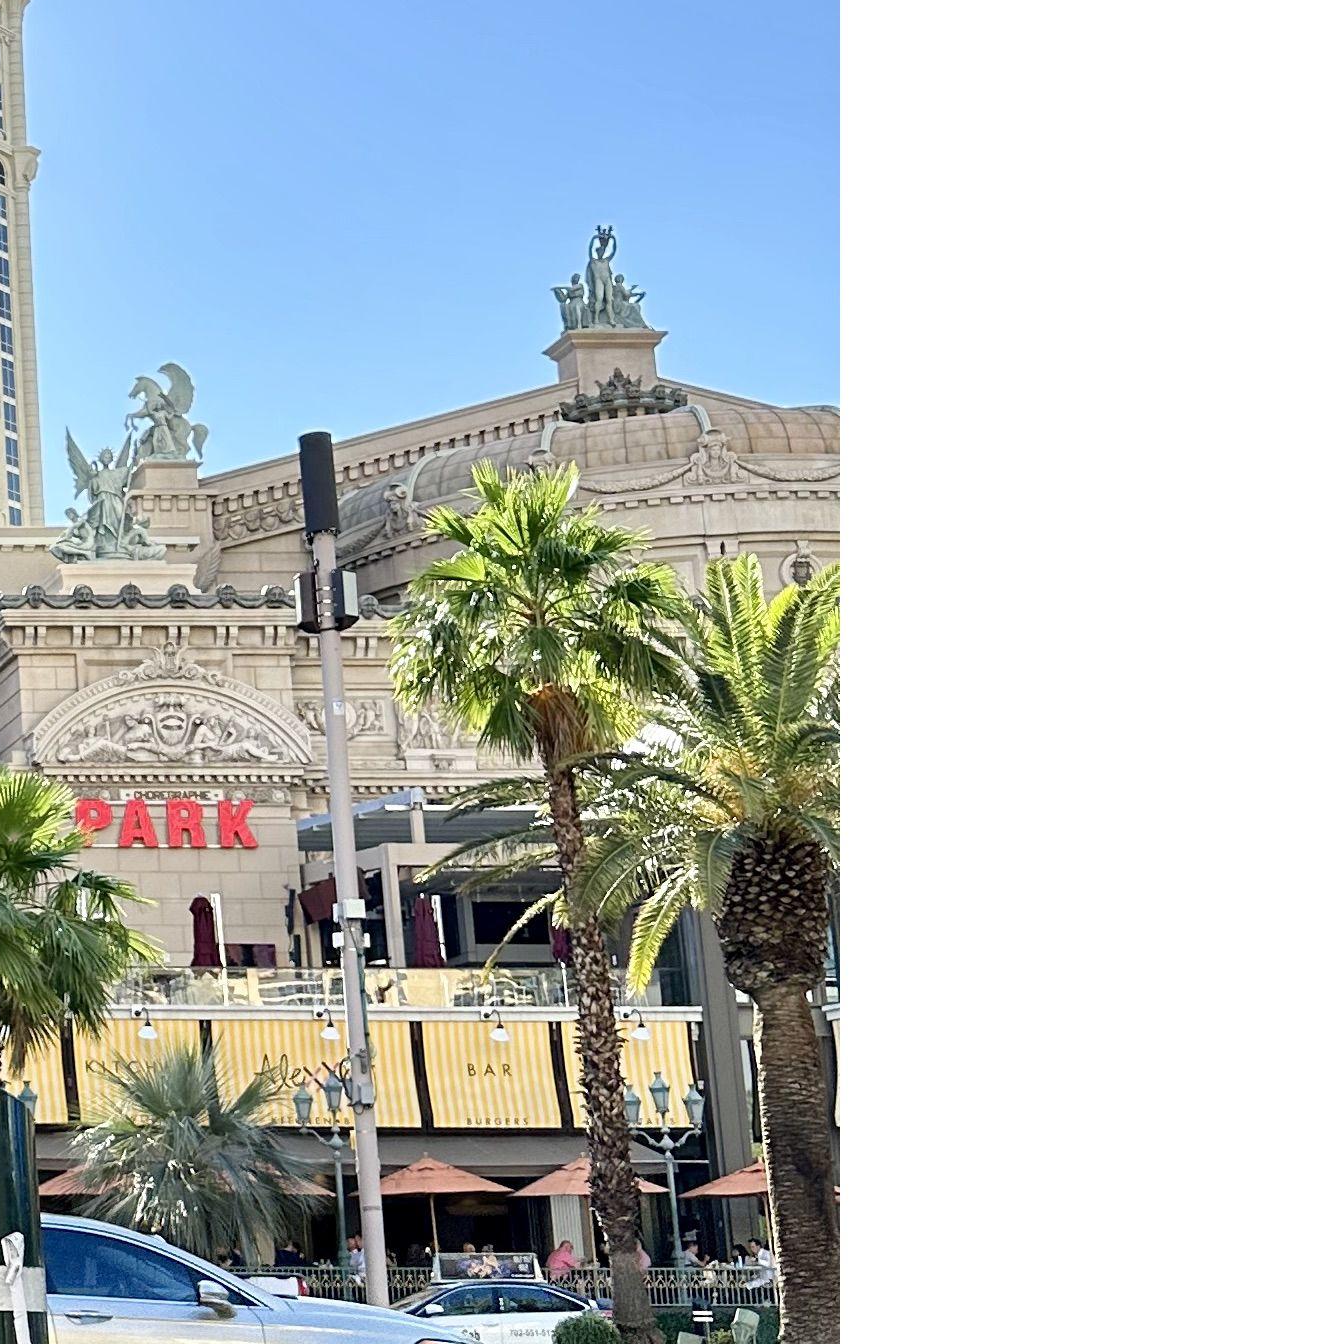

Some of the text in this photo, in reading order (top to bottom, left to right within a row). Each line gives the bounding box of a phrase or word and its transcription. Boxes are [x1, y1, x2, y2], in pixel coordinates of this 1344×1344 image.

[75, 799, 259, 850] PARK
[467, 1063, 513, 1078] BAR
[466, 1116, 529, 1126] BURGERS
